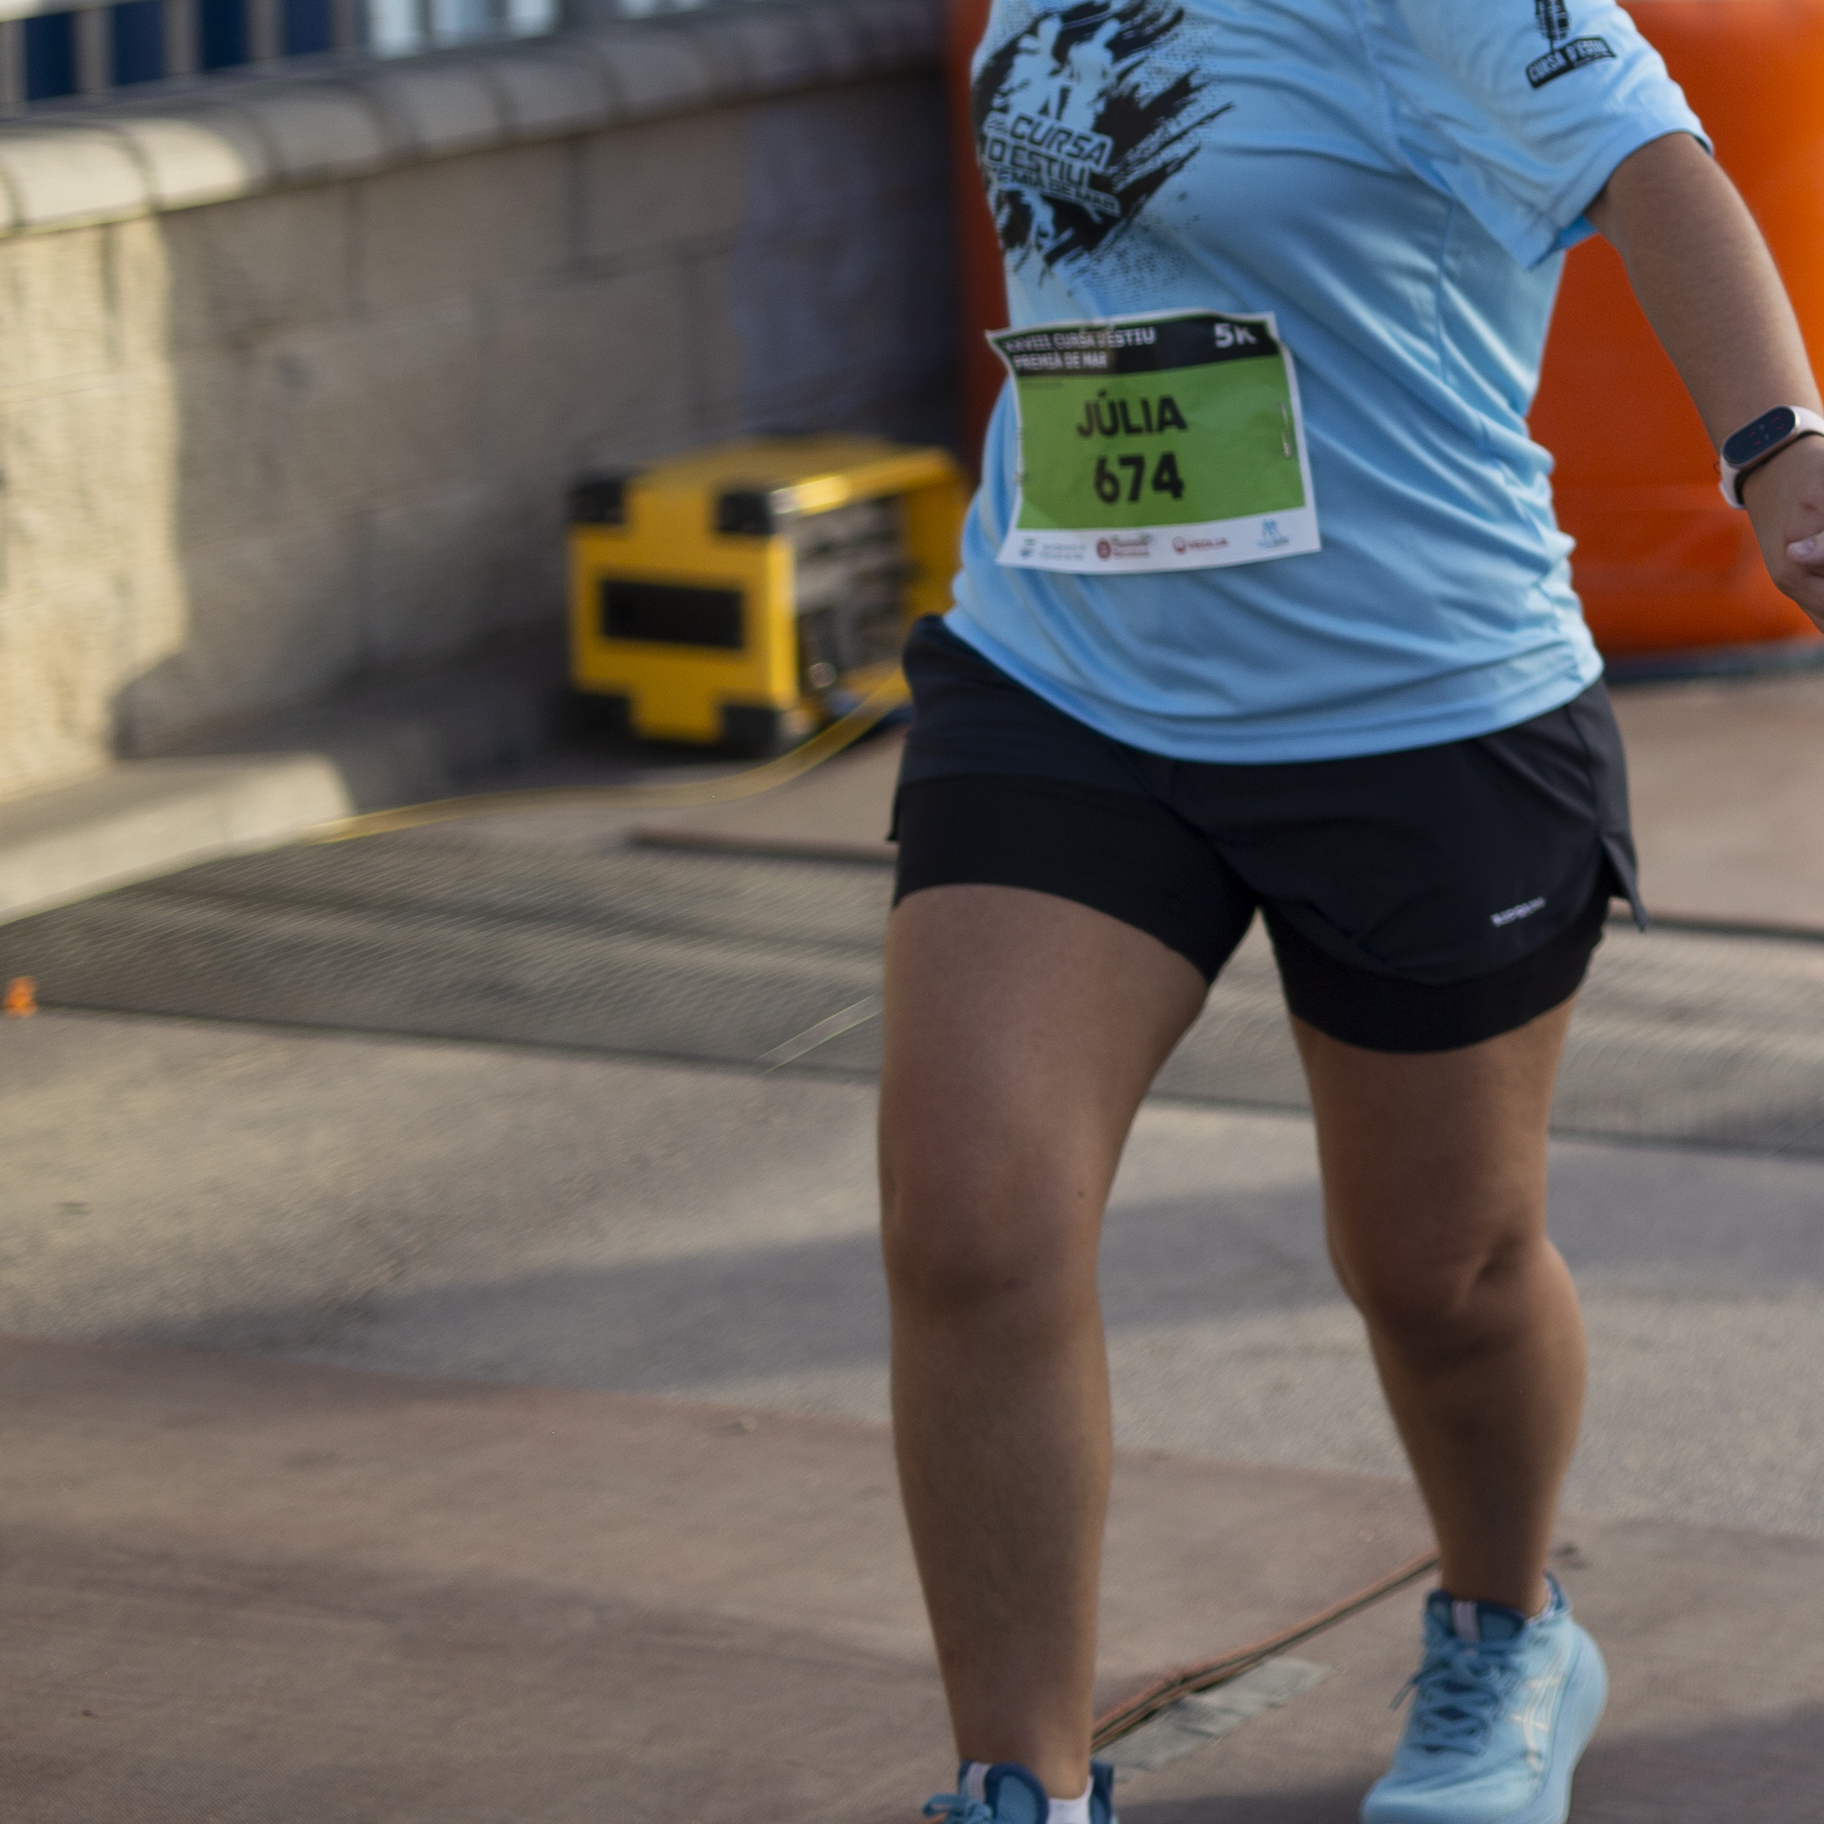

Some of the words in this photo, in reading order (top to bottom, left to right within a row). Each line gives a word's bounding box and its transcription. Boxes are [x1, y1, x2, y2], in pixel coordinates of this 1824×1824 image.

[1010, 115, 1107, 166] CURSA
[1077, 389, 1188, 438] JÚLIA
[1093, 452, 1185, 504] 674
